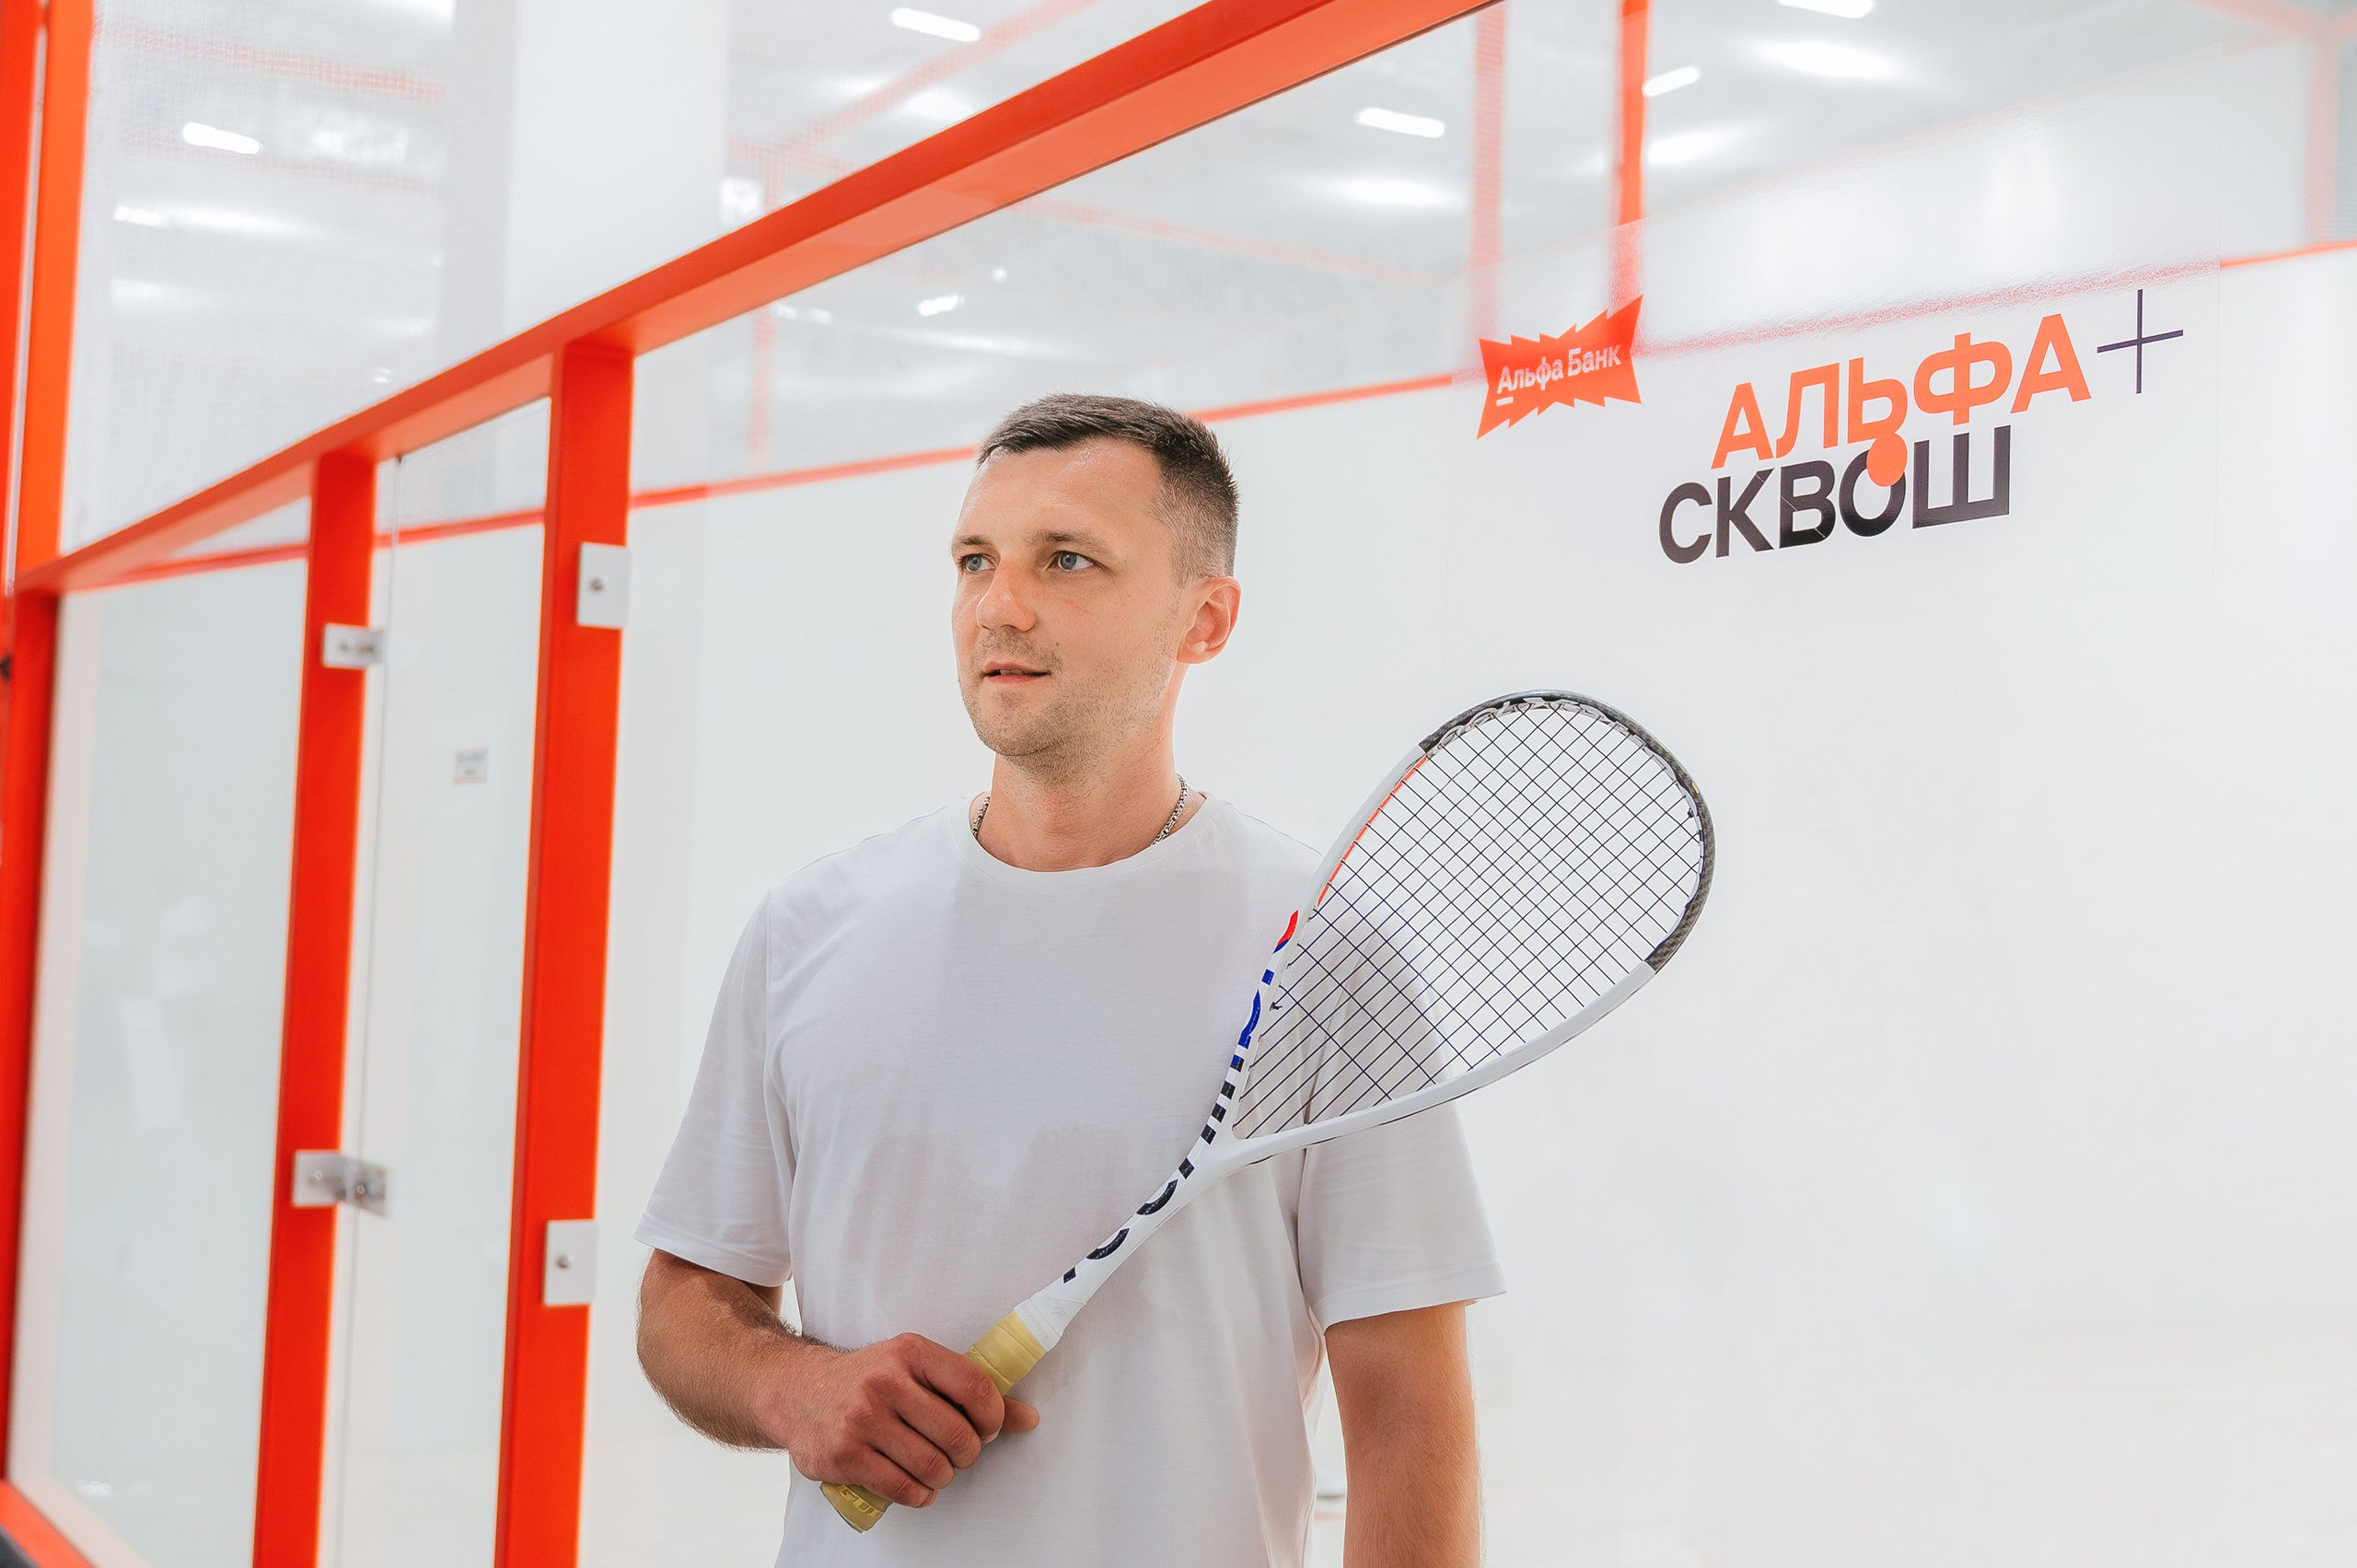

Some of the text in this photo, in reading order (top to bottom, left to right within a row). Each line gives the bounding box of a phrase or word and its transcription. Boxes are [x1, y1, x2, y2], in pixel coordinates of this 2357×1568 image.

[1496, 344, 1622, 396] Альфа Банк
[1658, 424, 2012, 564] СКВОШ
